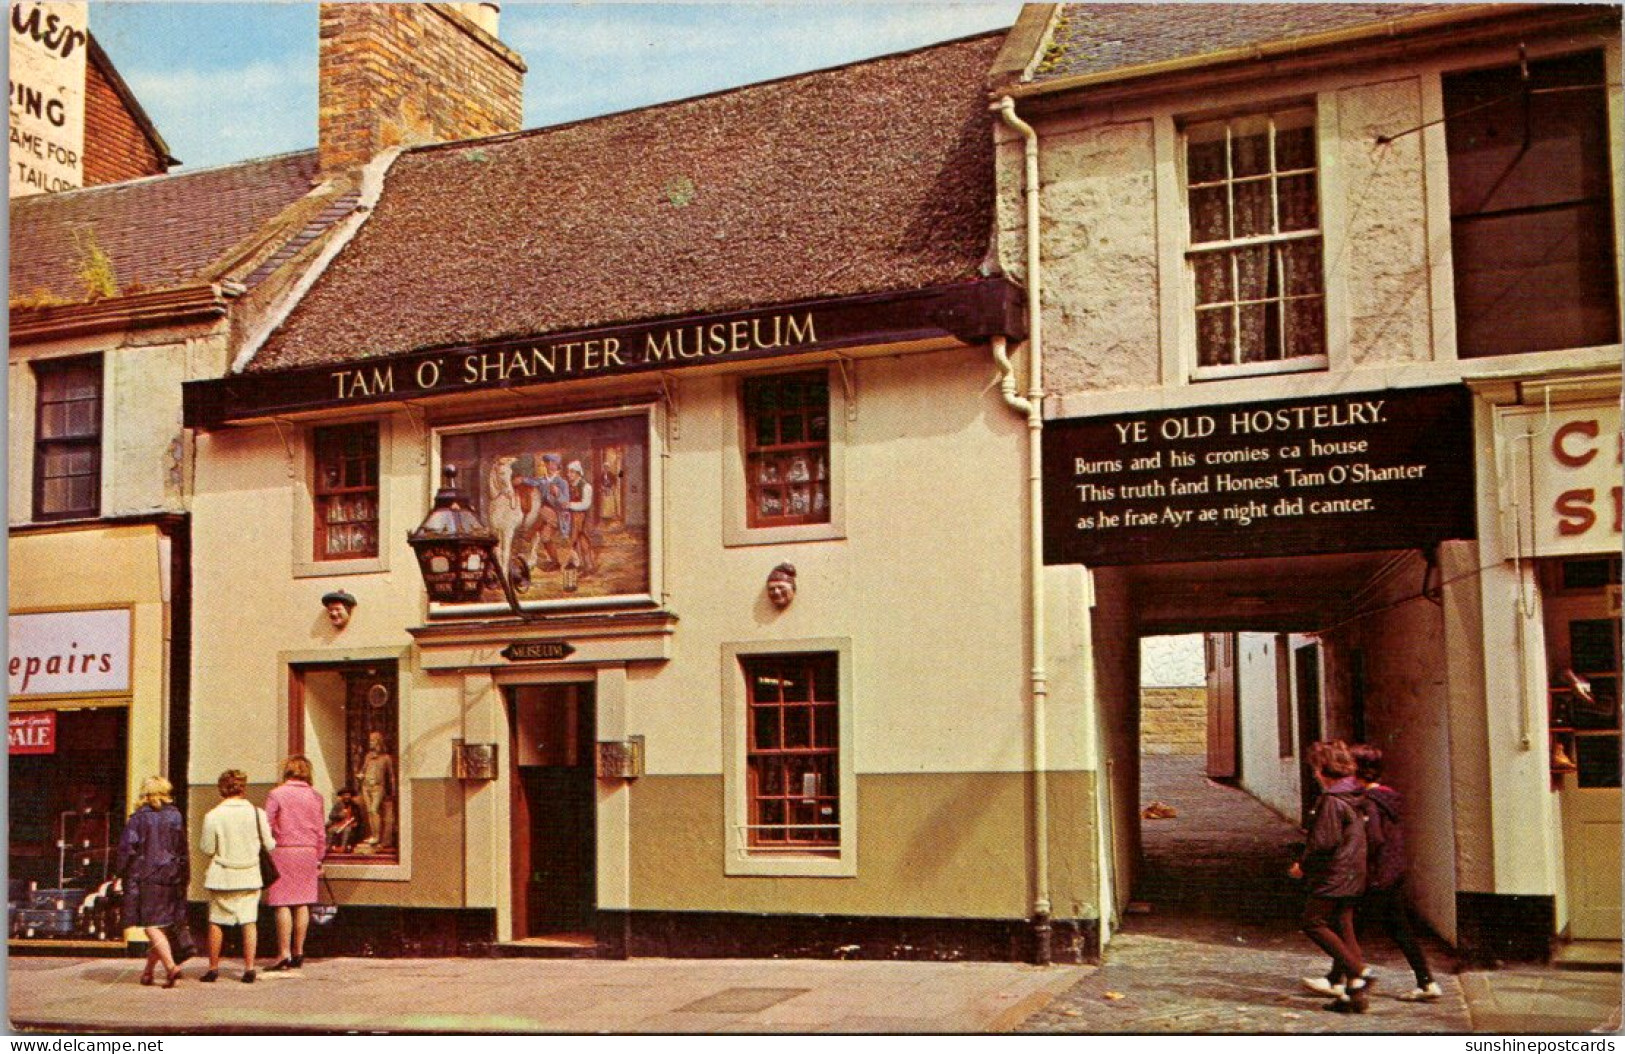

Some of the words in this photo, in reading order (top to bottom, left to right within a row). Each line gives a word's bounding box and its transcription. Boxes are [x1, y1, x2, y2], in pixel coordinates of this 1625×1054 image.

[47, 141, 77, 169] FOR
[331, 365, 395, 399] TAM
[416, 358, 444, 389] O'
[464, 337, 625, 384] SHANTER
[644, 312, 817, 363] MUSEUM
[1115, 420, 1148, 444] YE
[1160, 415, 1216, 440] OLD
[1230, 400, 1387, 435] HOSTELRY.
[1074, 456, 1123, 475] Burns
[1130, 451, 1161, 471] and
[1170, 449, 1196, 468] his
[1205, 446, 1270, 465] cronies
[1279, 446, 1301, 459] ca
[1310, 438, 1369, 456] house
[1552, 419, 1623, 468] C
[1076, 483, 1116, 502] This
[1121, 479, 1166, 499] truth
[1170, 475, 1209, 496] fand
[1216, 473, 1280, 492] Honest
[1284, 467, 1325, 487] Tam
[1077, 516, 1095, 530] as
[1098, 510, 1120, 528] he
[1125, 508, 1158, 527] frae
[1161, 505, 1193, 528] Ayr
[1198, 507, 1218, 522] ae
[1223, 500, 1268, 526] night
[1273, 497, 1304, 517] did
[1310, 497, 1376, 515] canter.
[9, 641, 112, 692] epairs
[511, 644, 563, 658] MUSEUM
